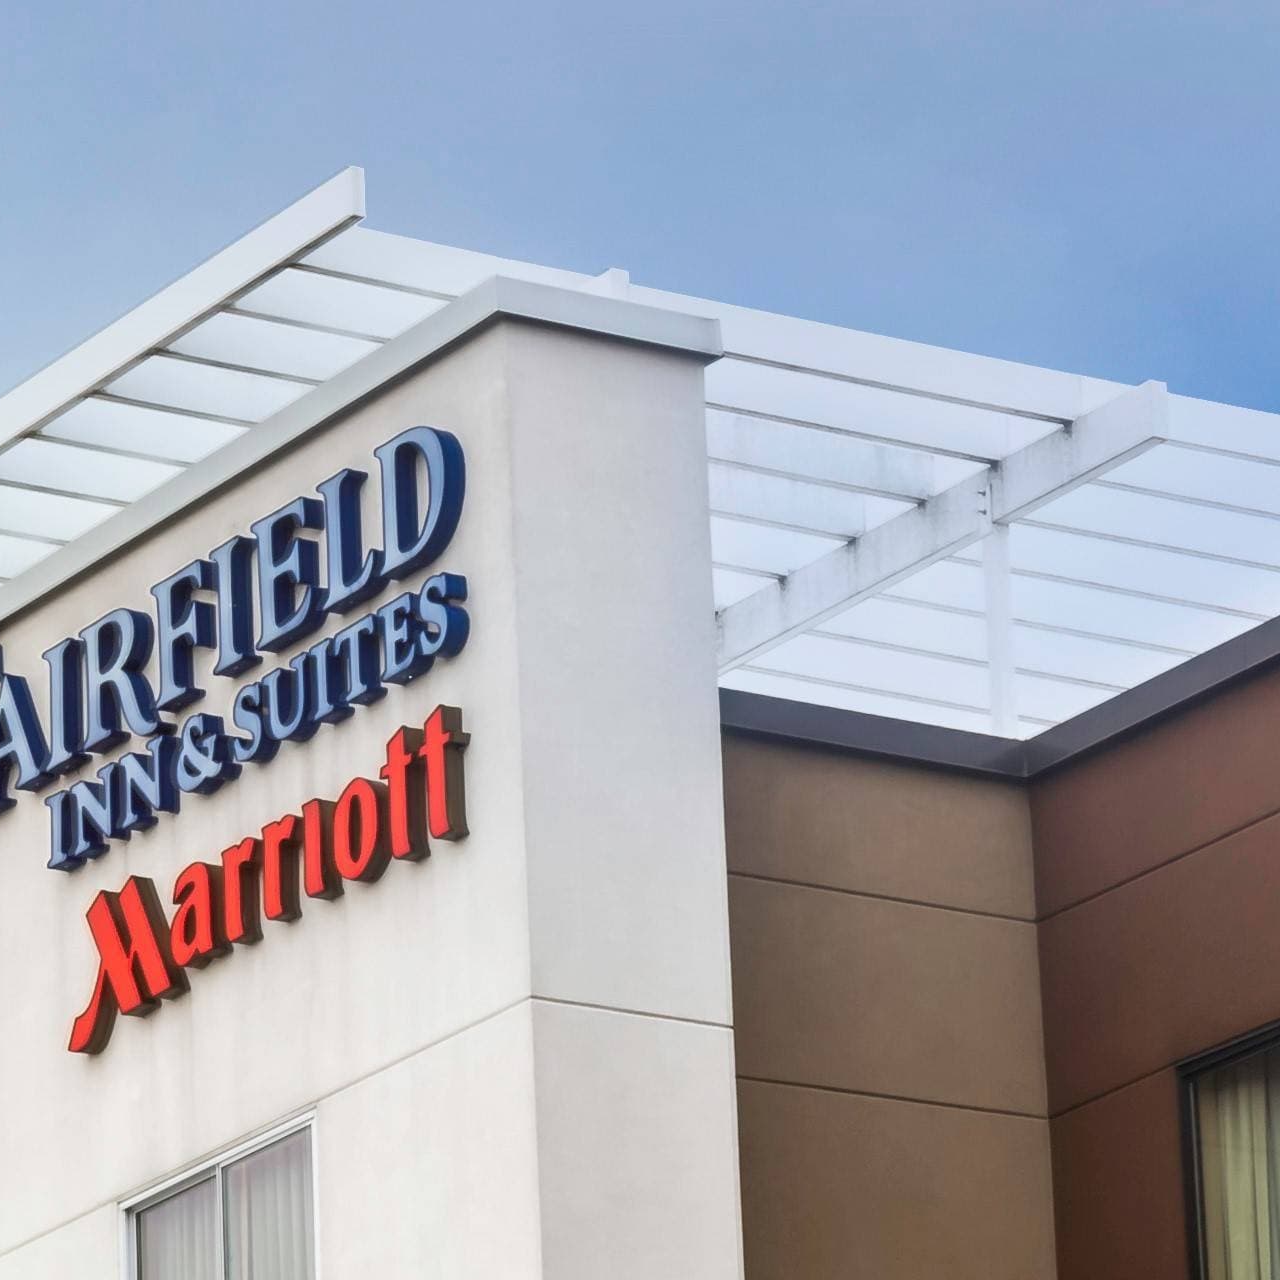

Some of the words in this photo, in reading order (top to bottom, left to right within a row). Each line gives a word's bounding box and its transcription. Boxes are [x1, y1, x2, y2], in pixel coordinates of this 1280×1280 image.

[44, 734, 181, 872] INN
[173, 712, 242, 795] &
[232, 571, 471, 764] SUITES
[68, 704, 471, 1055] Marriott
